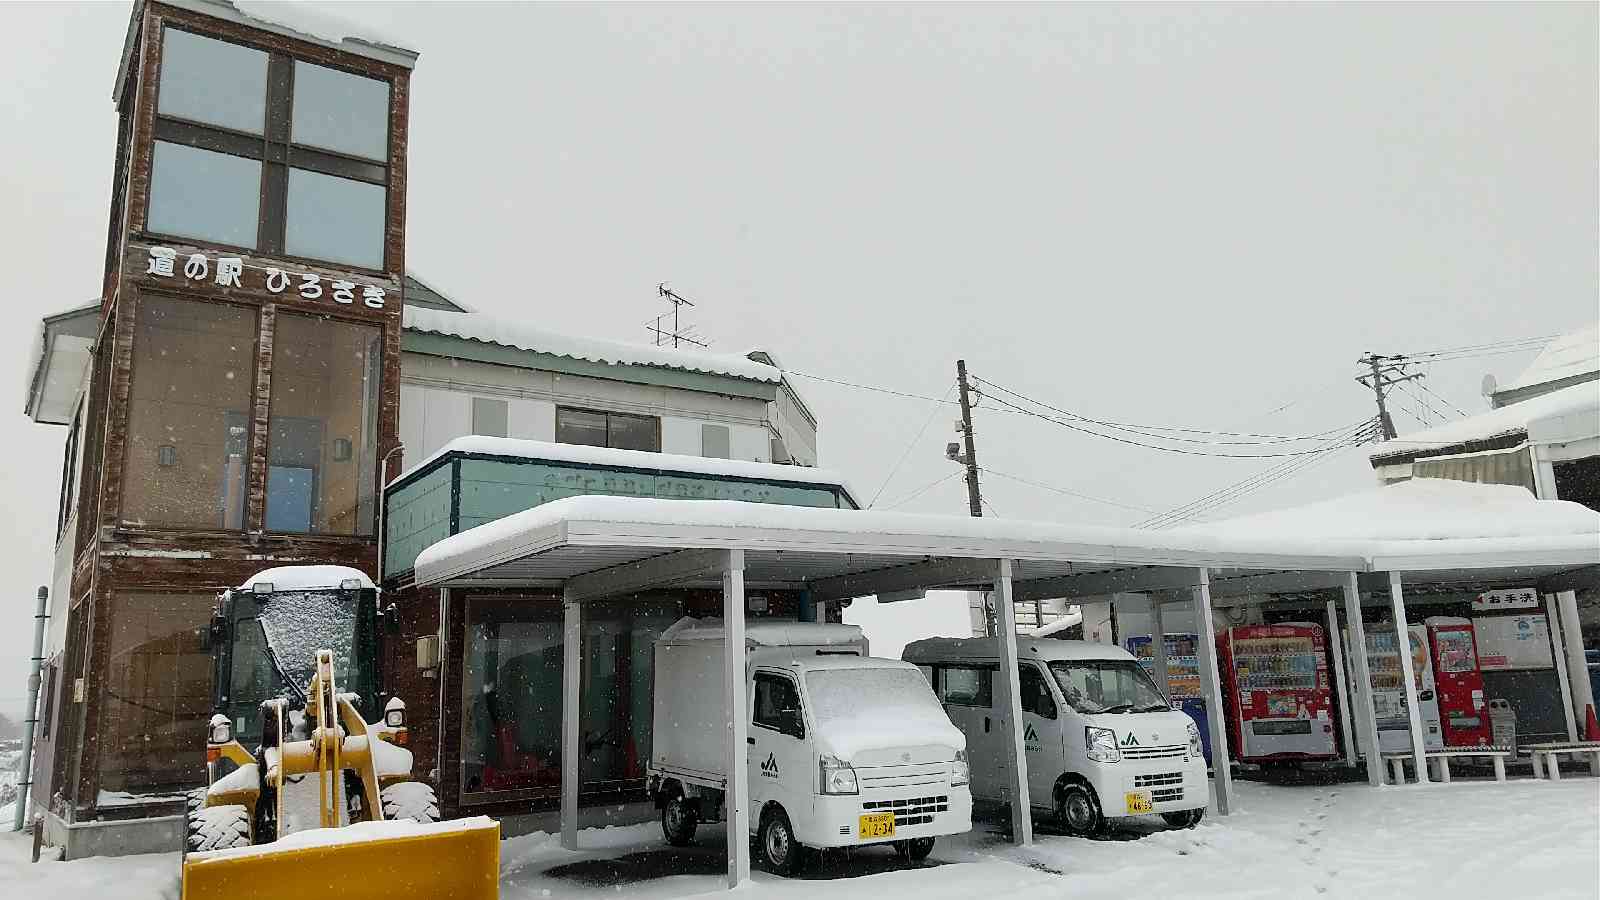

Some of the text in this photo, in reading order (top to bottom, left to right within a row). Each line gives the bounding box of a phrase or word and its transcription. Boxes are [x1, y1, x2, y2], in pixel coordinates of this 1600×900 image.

[147, 246, 386, 308] 道の駅 ひろさき
[1488, 592, 1535, 604] お手洗
